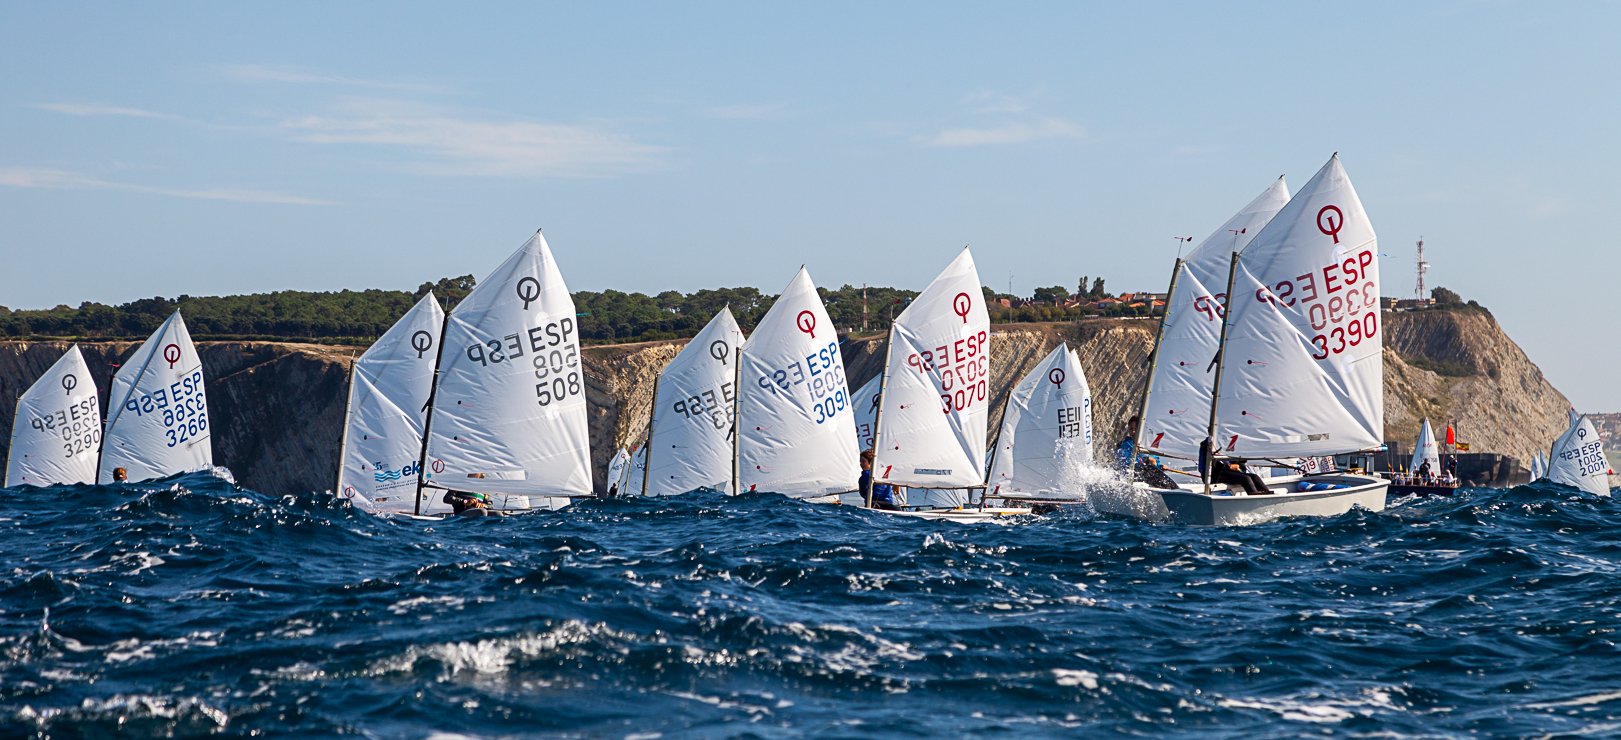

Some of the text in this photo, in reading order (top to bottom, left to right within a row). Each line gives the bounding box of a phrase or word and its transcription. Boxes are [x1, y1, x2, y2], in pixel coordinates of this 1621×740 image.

[1323, 250, 1373, 294] ESP
[527, 317, 573, 353] ESP
[954, 330, 987, 363] ESP
[1311, 311, 1377, 360] 3390
[806, 342, 837, 377] ESP
[170, 371, 201, 402] ESP
[536, 371, 580, 406] 508
[941, 379, 986, 414] 3070
[70, 395, 97, 421] ESP
[813, 386, 849, 424] 3091
[63, 429, 101, 458] 3290
[166, 412, 207, 447] 3266
[1581, 441, 1601, 456] ESP
[1580, 461, 1606, 477] 2001
